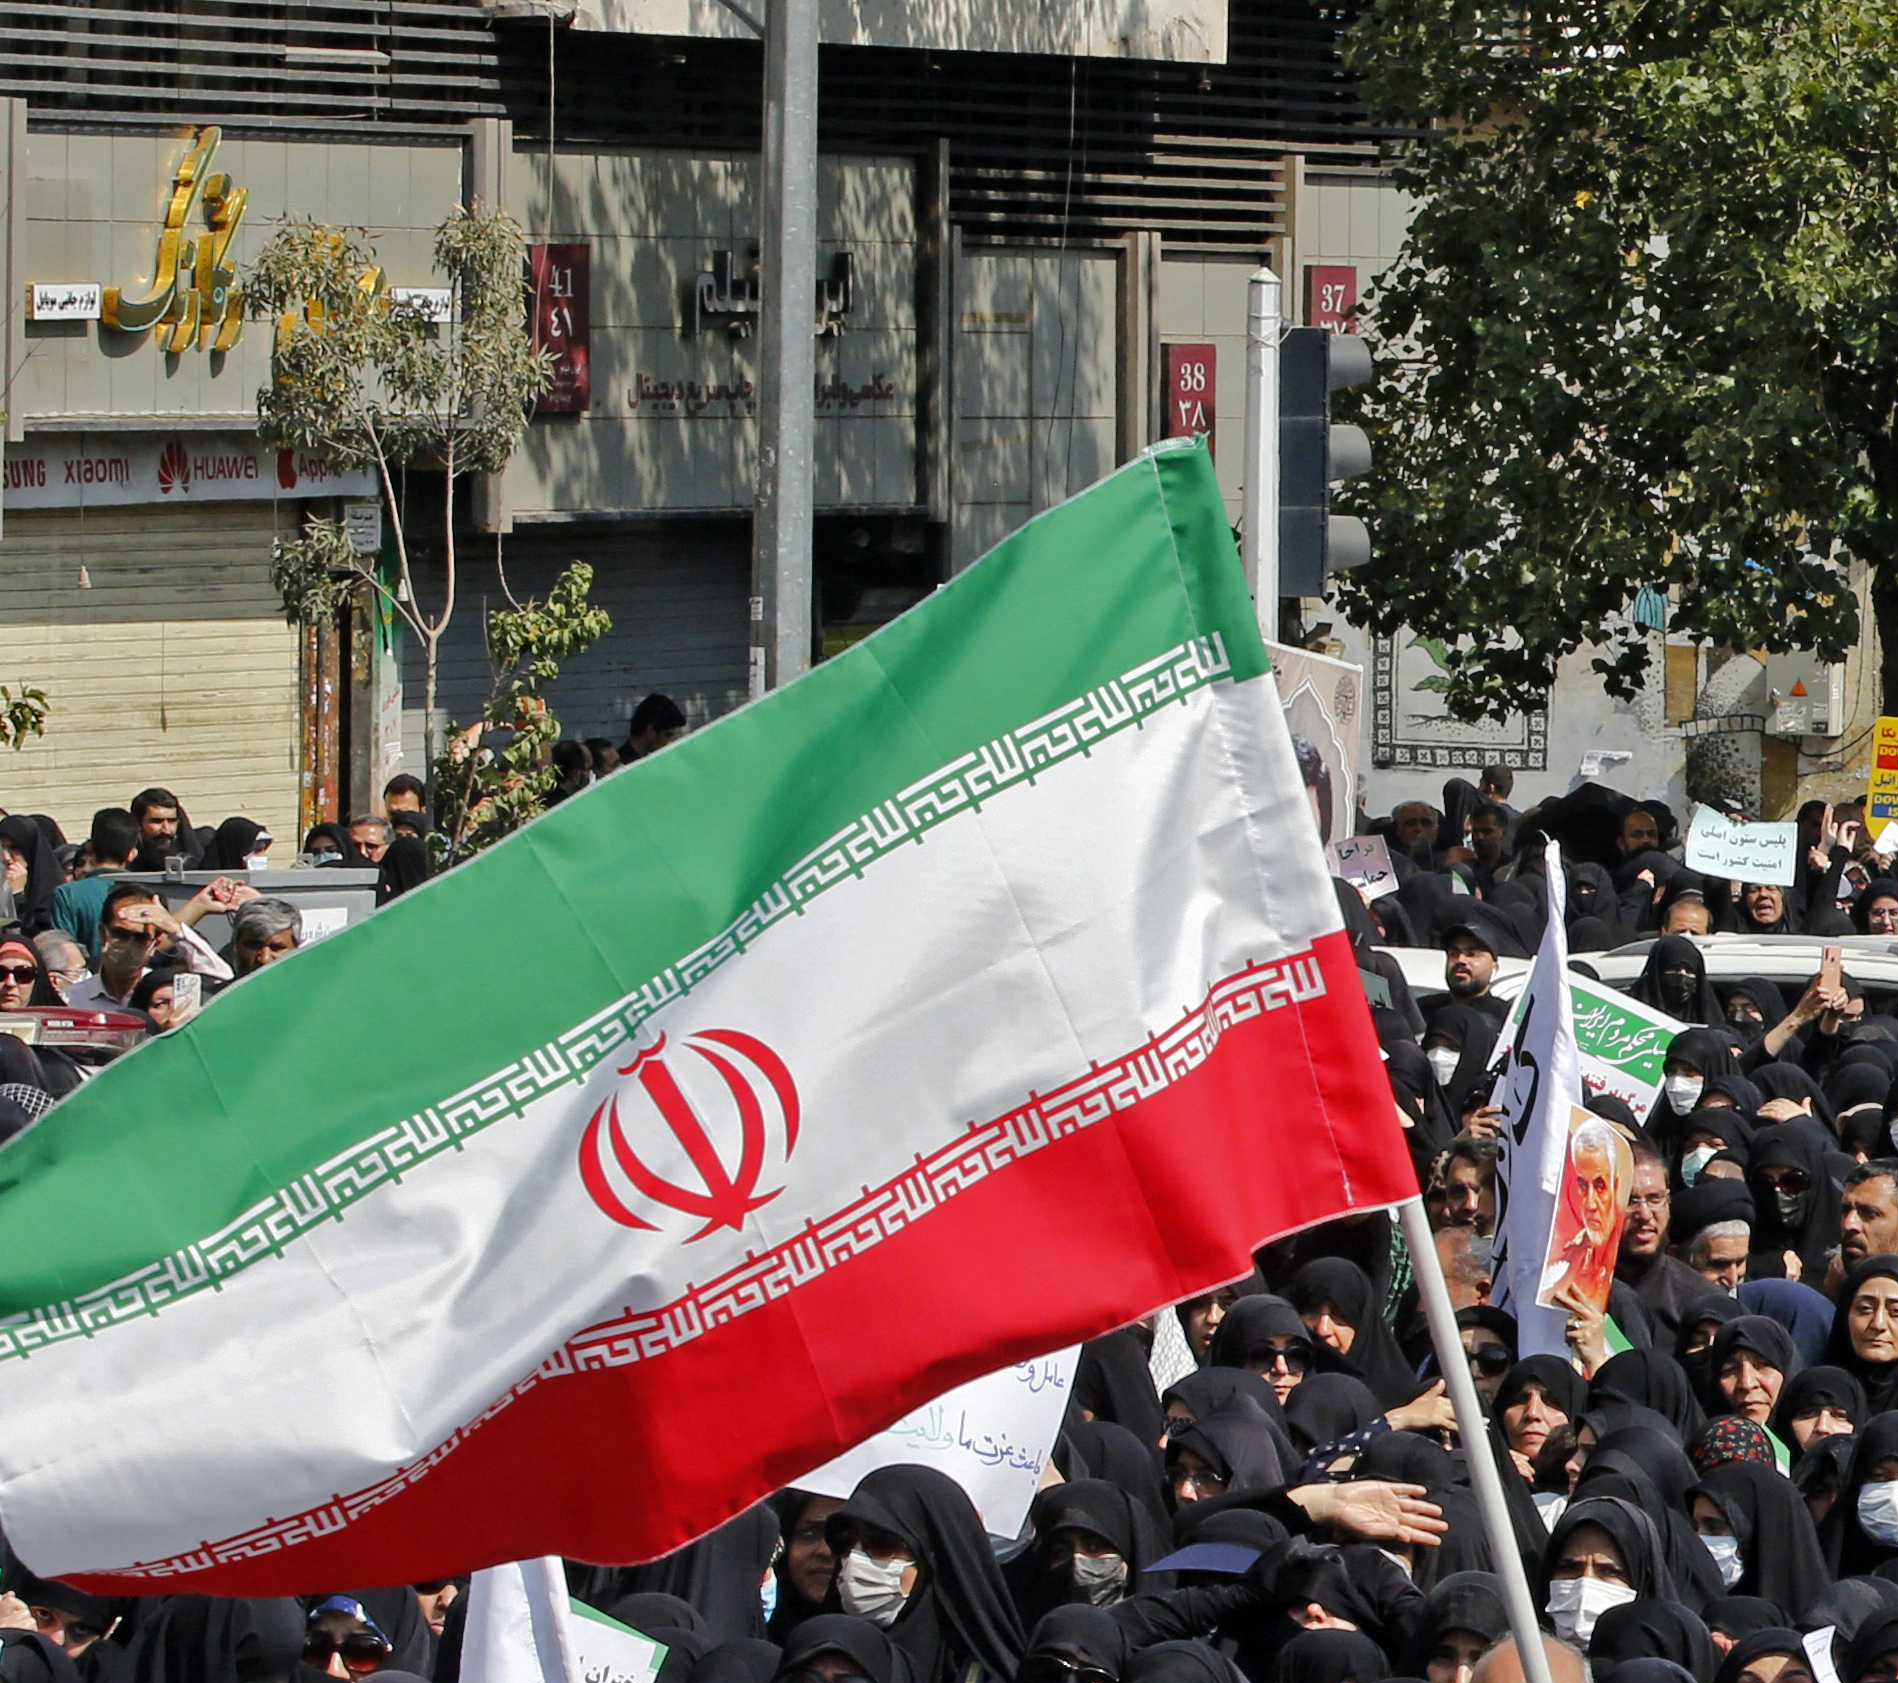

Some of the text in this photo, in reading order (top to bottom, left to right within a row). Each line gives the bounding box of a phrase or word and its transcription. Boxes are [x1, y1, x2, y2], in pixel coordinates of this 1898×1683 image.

[549, 264, 573, 298] 41
[1321, 284, 1346, 314] 37
[1180, 363, 1206, 391] 38
[193, 455, 259, 480] HUAWEI
[1700, 825, 1787, 848] پلیس ستون اصلی
[1697, 851, 1782, 871] امنیت کشور است
